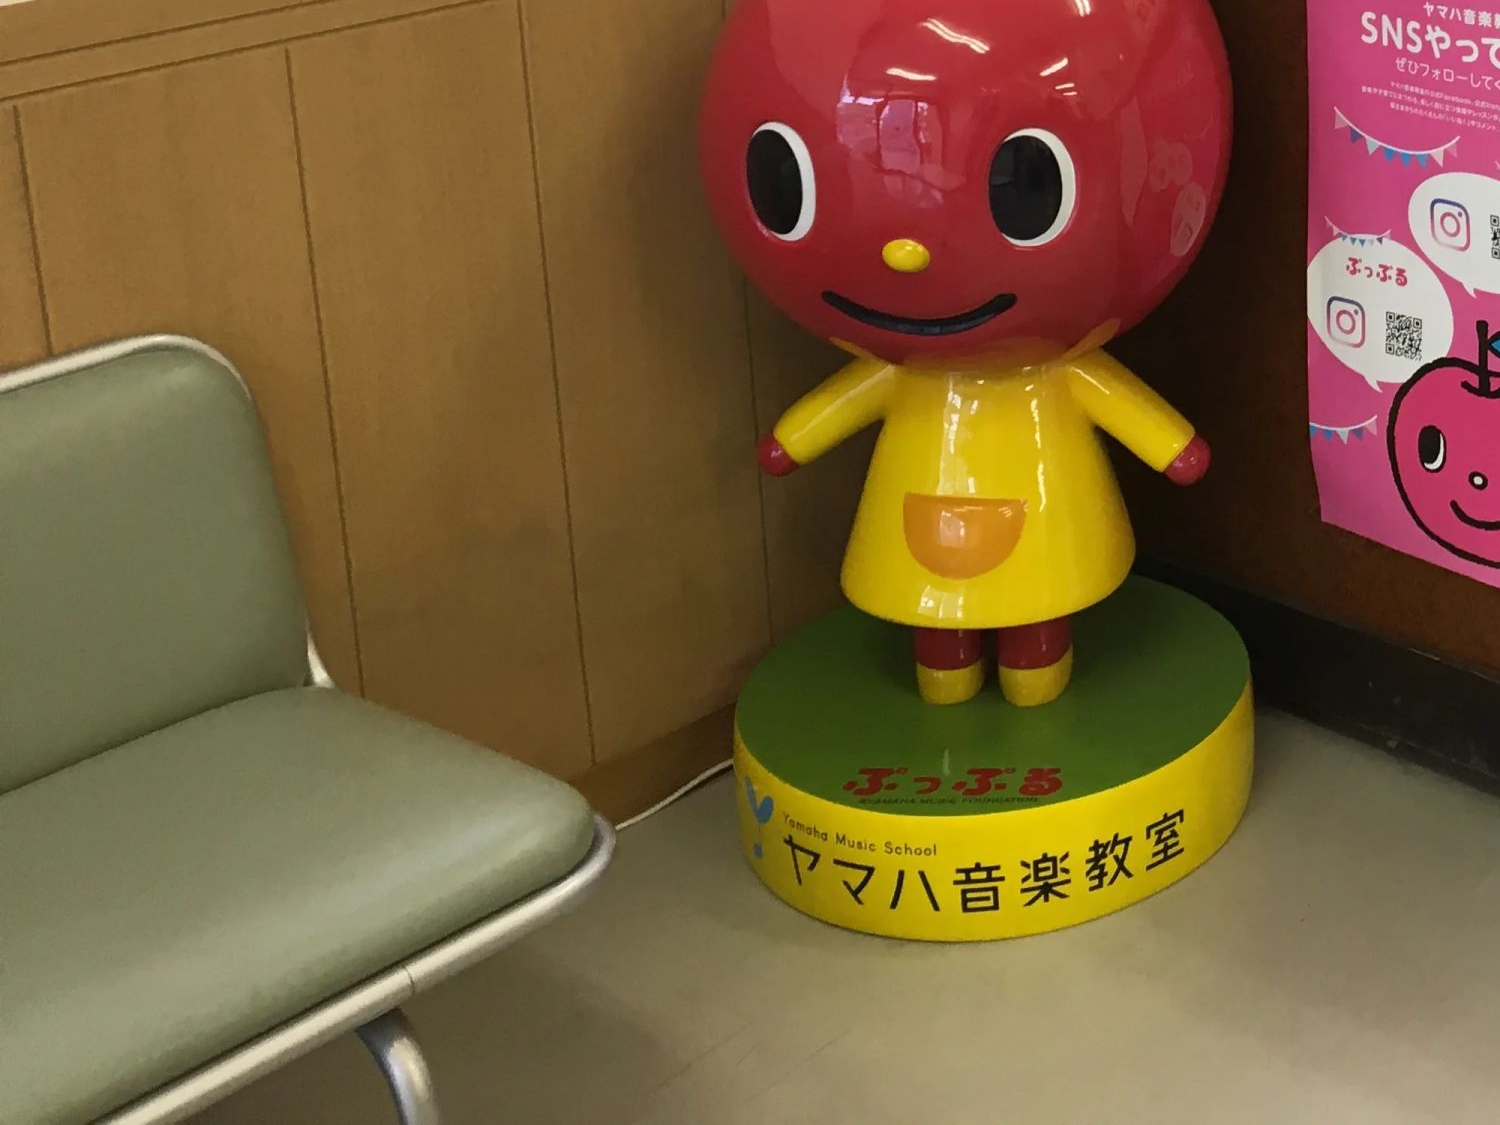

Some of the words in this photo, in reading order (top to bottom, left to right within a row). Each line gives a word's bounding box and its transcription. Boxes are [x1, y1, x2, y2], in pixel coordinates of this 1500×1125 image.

[1345, 256, 1408, 287] ぷっぷる
[842, 766, 1063, 796] ぷっぷる
[783, 811, 829, 842] Yamaha
[835, 832, 877, 852] Music
[884, 841, 937, 857] School
[783, 808, 1186, 915] ヤマハ音楽教室
